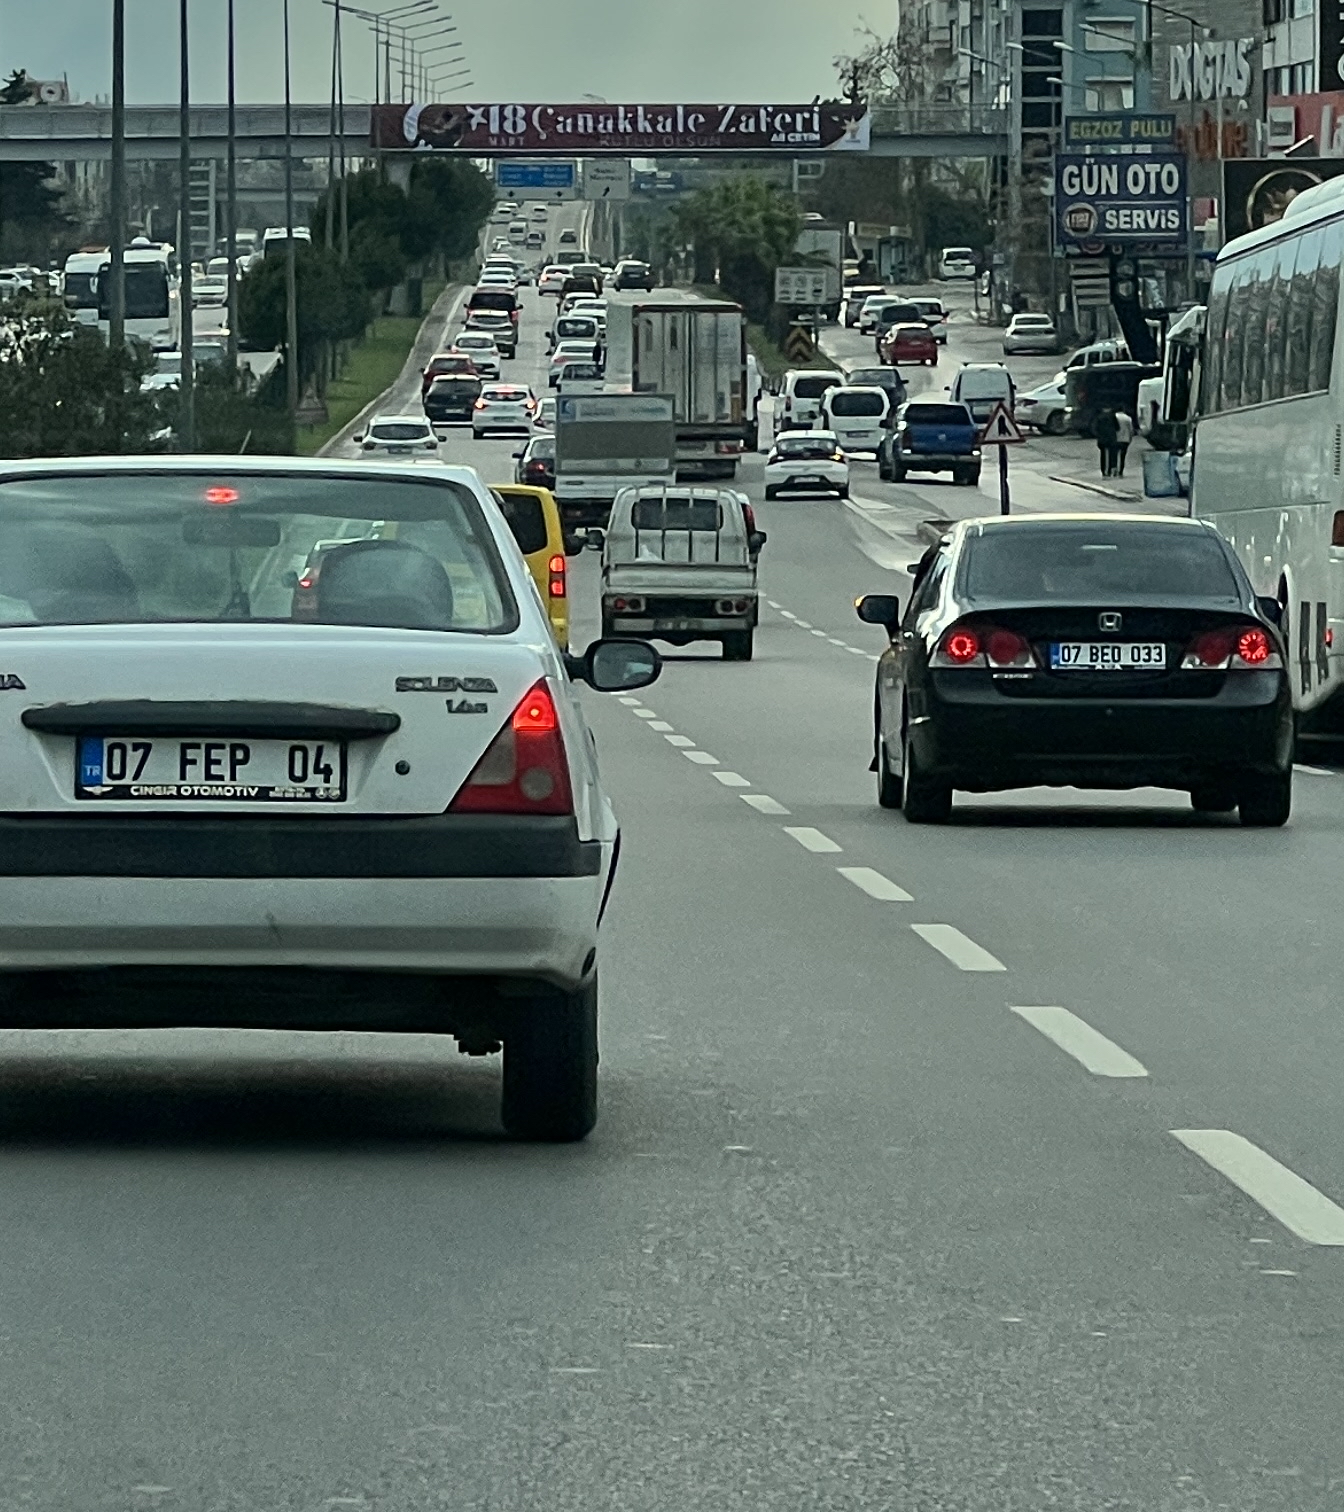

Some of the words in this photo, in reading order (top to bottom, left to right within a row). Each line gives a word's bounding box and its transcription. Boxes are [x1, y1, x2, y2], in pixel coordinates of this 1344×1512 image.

[531, 104, 706, 140] Çanakkale
[716, 104, 820, 134] Zaferi
[1069, 120, 1124, 139] EGZOZ
[1130, 119, 1173, 138] PULU
[1062, 157, 1119, 196] GÜN
[1126, 162, 1180, 196] OTO
[1060, 645, 1082, 664] 07
[1130, 645, 1163, 664] 033
[85, 765, 101, 776] TR
[106, 741, 153, 782] 07
[179, 742, 251, 782] FEP
[287, 744, 334, 785] 04
